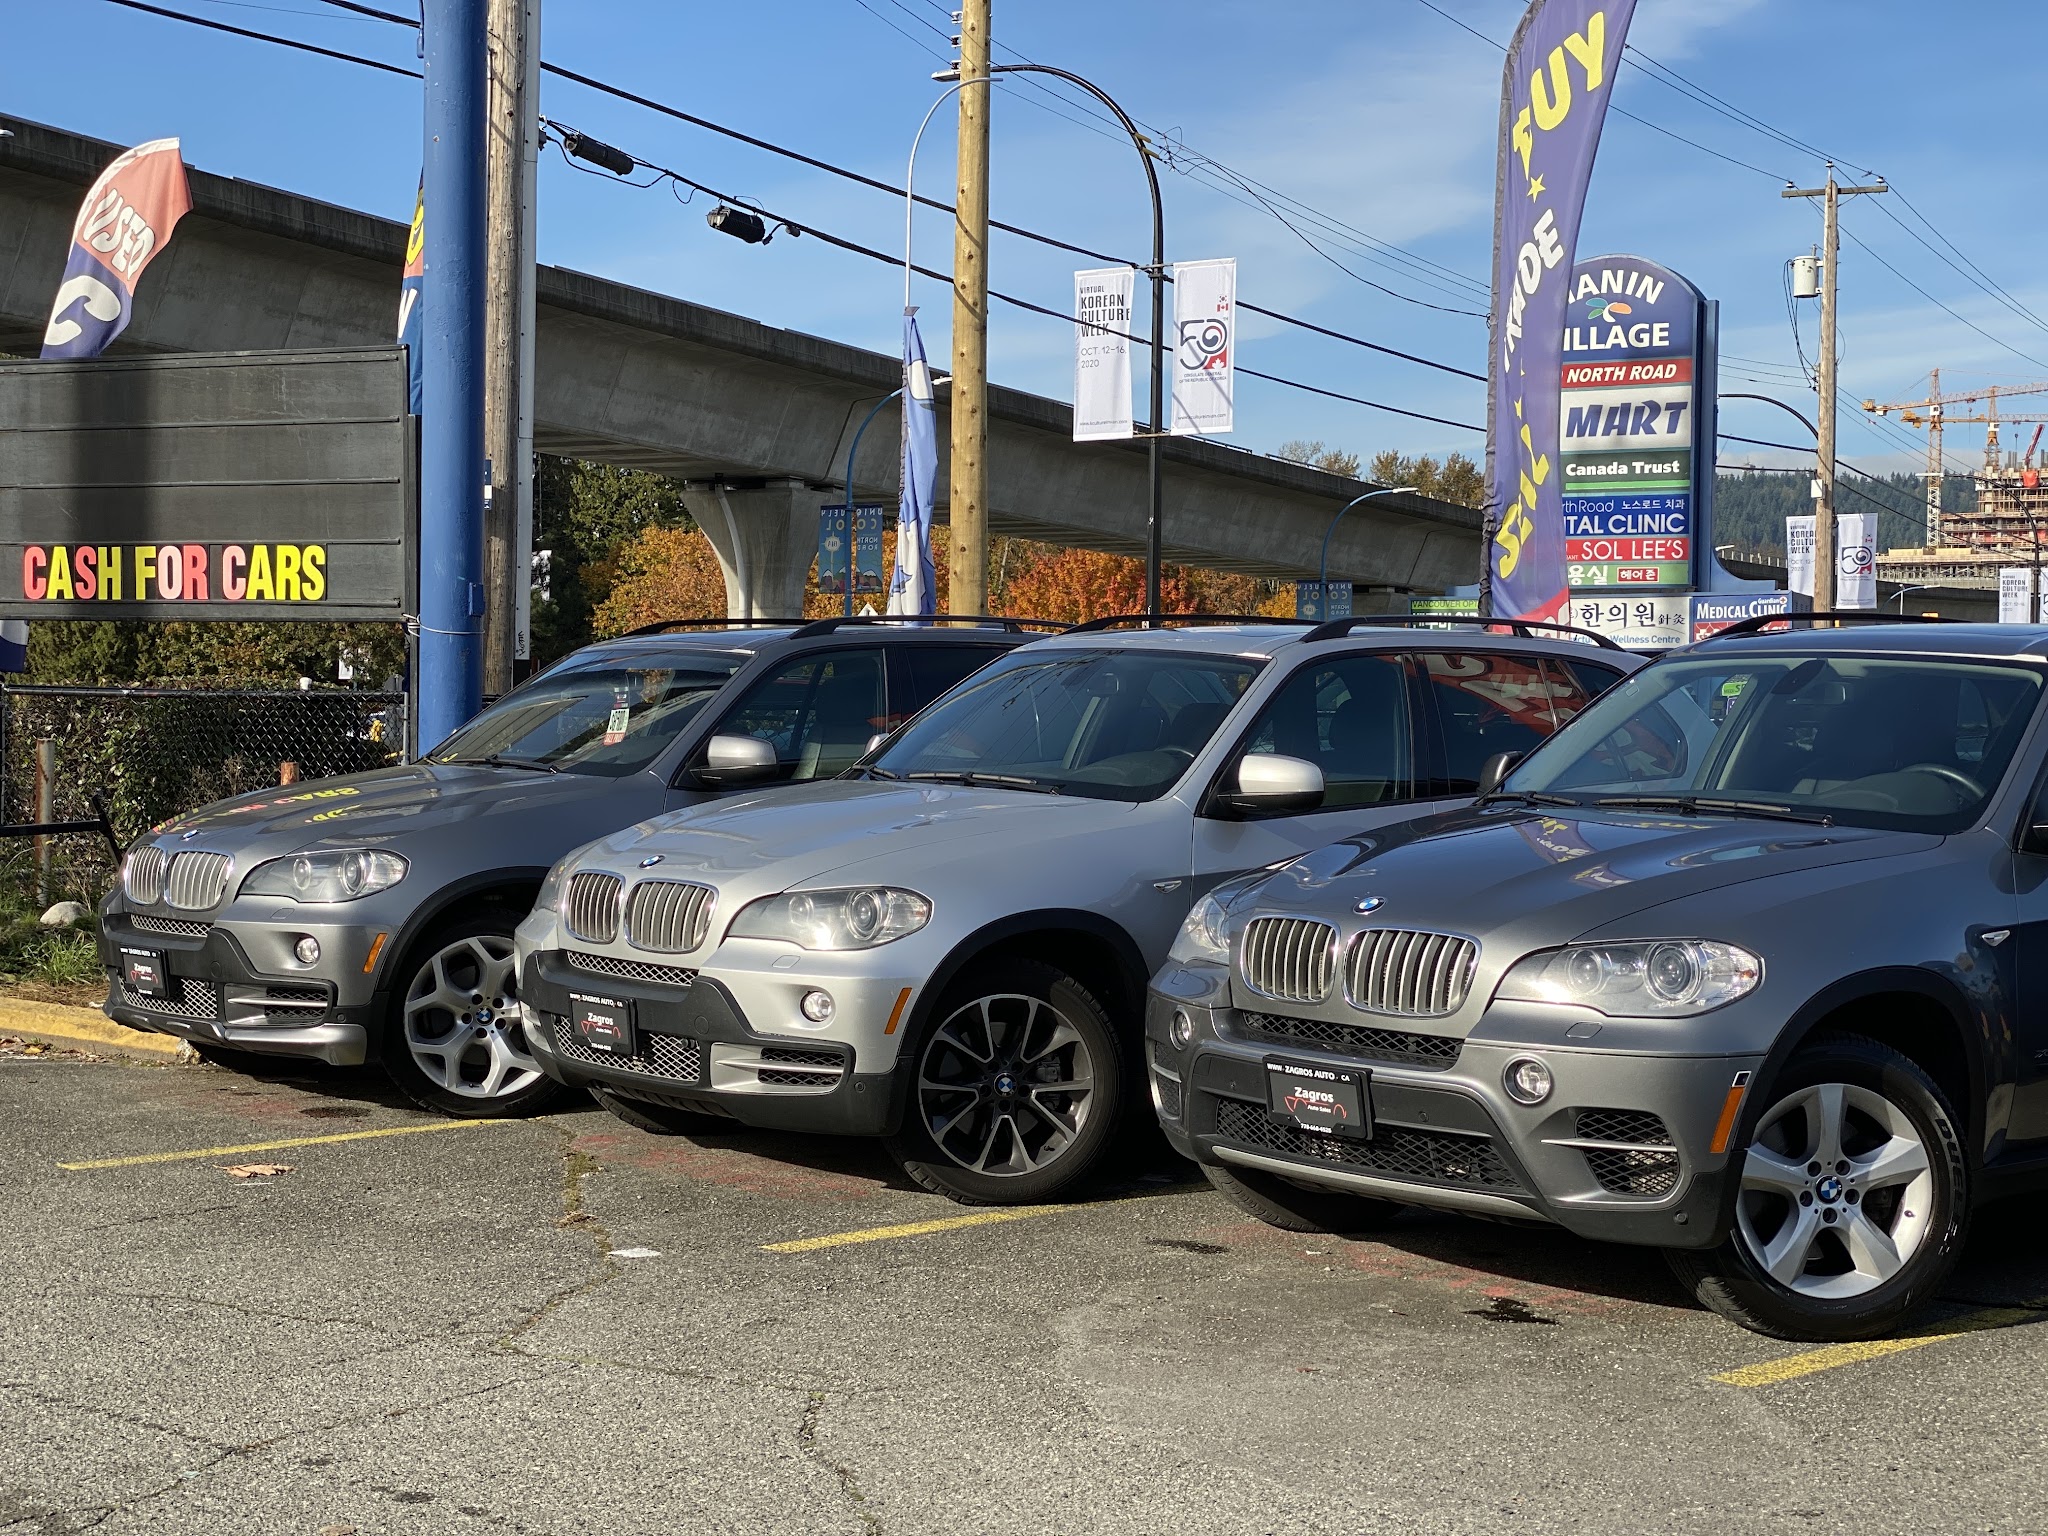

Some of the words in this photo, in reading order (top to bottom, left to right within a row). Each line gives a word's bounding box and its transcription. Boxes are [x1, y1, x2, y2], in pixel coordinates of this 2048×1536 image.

[83, 188, 155, 281] USED
[1080, 285, 1105, 294] VIRTUAL
[1568, 269, 1665, 305] ANIN
[1081, 294, 1124, 310] KOREAN
[1081, 308, 1130, 323] CULTURE
[1081, 323, 1109, 337] WEEK
[1563, 322, 1670, 351] ILLAGE
[1081, 359, 1099, 368] 2020
[1567, 366, 1627, 383] NORTH
[1629, 364, 1677, 380] ROAD
[1566, 400, 1689, 438] MART
[1565, 461, 1628, 476] Canada
[1632, 460, 1680, 474] Trust
[1564, 515, 1604, 534] TAL
[1608, 513, 1685, 534] CLINIC
[1581, 541, 1623, 560] SOL
[1631, 539, 1684, 560] LEE'S
[24, 545, 122, 600] CASH
[135, 545, 209, 600] FOR
[222, 544, 326, 600] CARS
[1567, 565, 1608, 585] 용실
[1412, 600, 1460, 608] VANCOUVER
[1757, 597, 1780, 605] Guardian
[1580, 602, 1656, 628] 한의원
[1610, 635, 1649, 644] Wellness
[1651, 635, 1681, 644] Centre
[587, 1012, 614, 1026] Zagros
[1284, 1065, 1314, 1077] ZAGROS
[1294, 1087, 1334, 1103] Zagros
